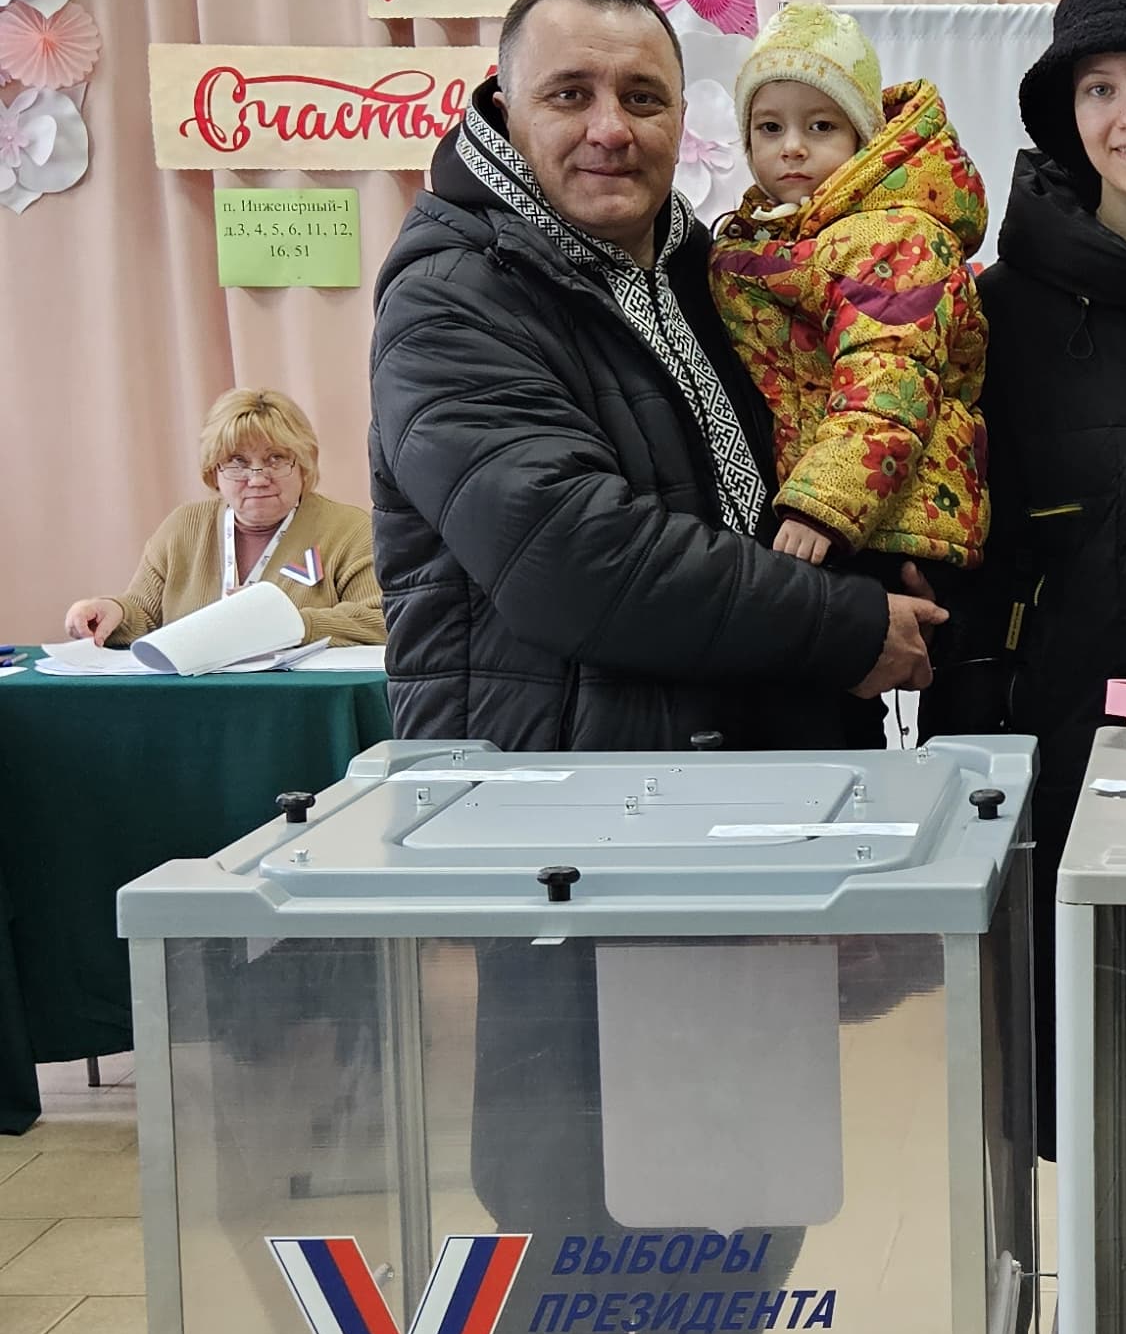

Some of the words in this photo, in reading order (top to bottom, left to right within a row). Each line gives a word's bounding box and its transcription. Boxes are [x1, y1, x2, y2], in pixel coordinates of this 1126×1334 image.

[223, 203, 236, 213] п.
[241, 199, 349, 215] Инженерный-1
[254, 223, 267, 236] 4,
[271, 223, 284, 236] 5,
[288, 223, 301, 236] 6,
[307, 223, 327, 236] 11,
[333, 223, 353, 237] 12,
[270, 245, 290, 259] 16,
[294, 245, 310, 257] 51
[553, 1231, 770, 1277] ВЫБОРЫ
